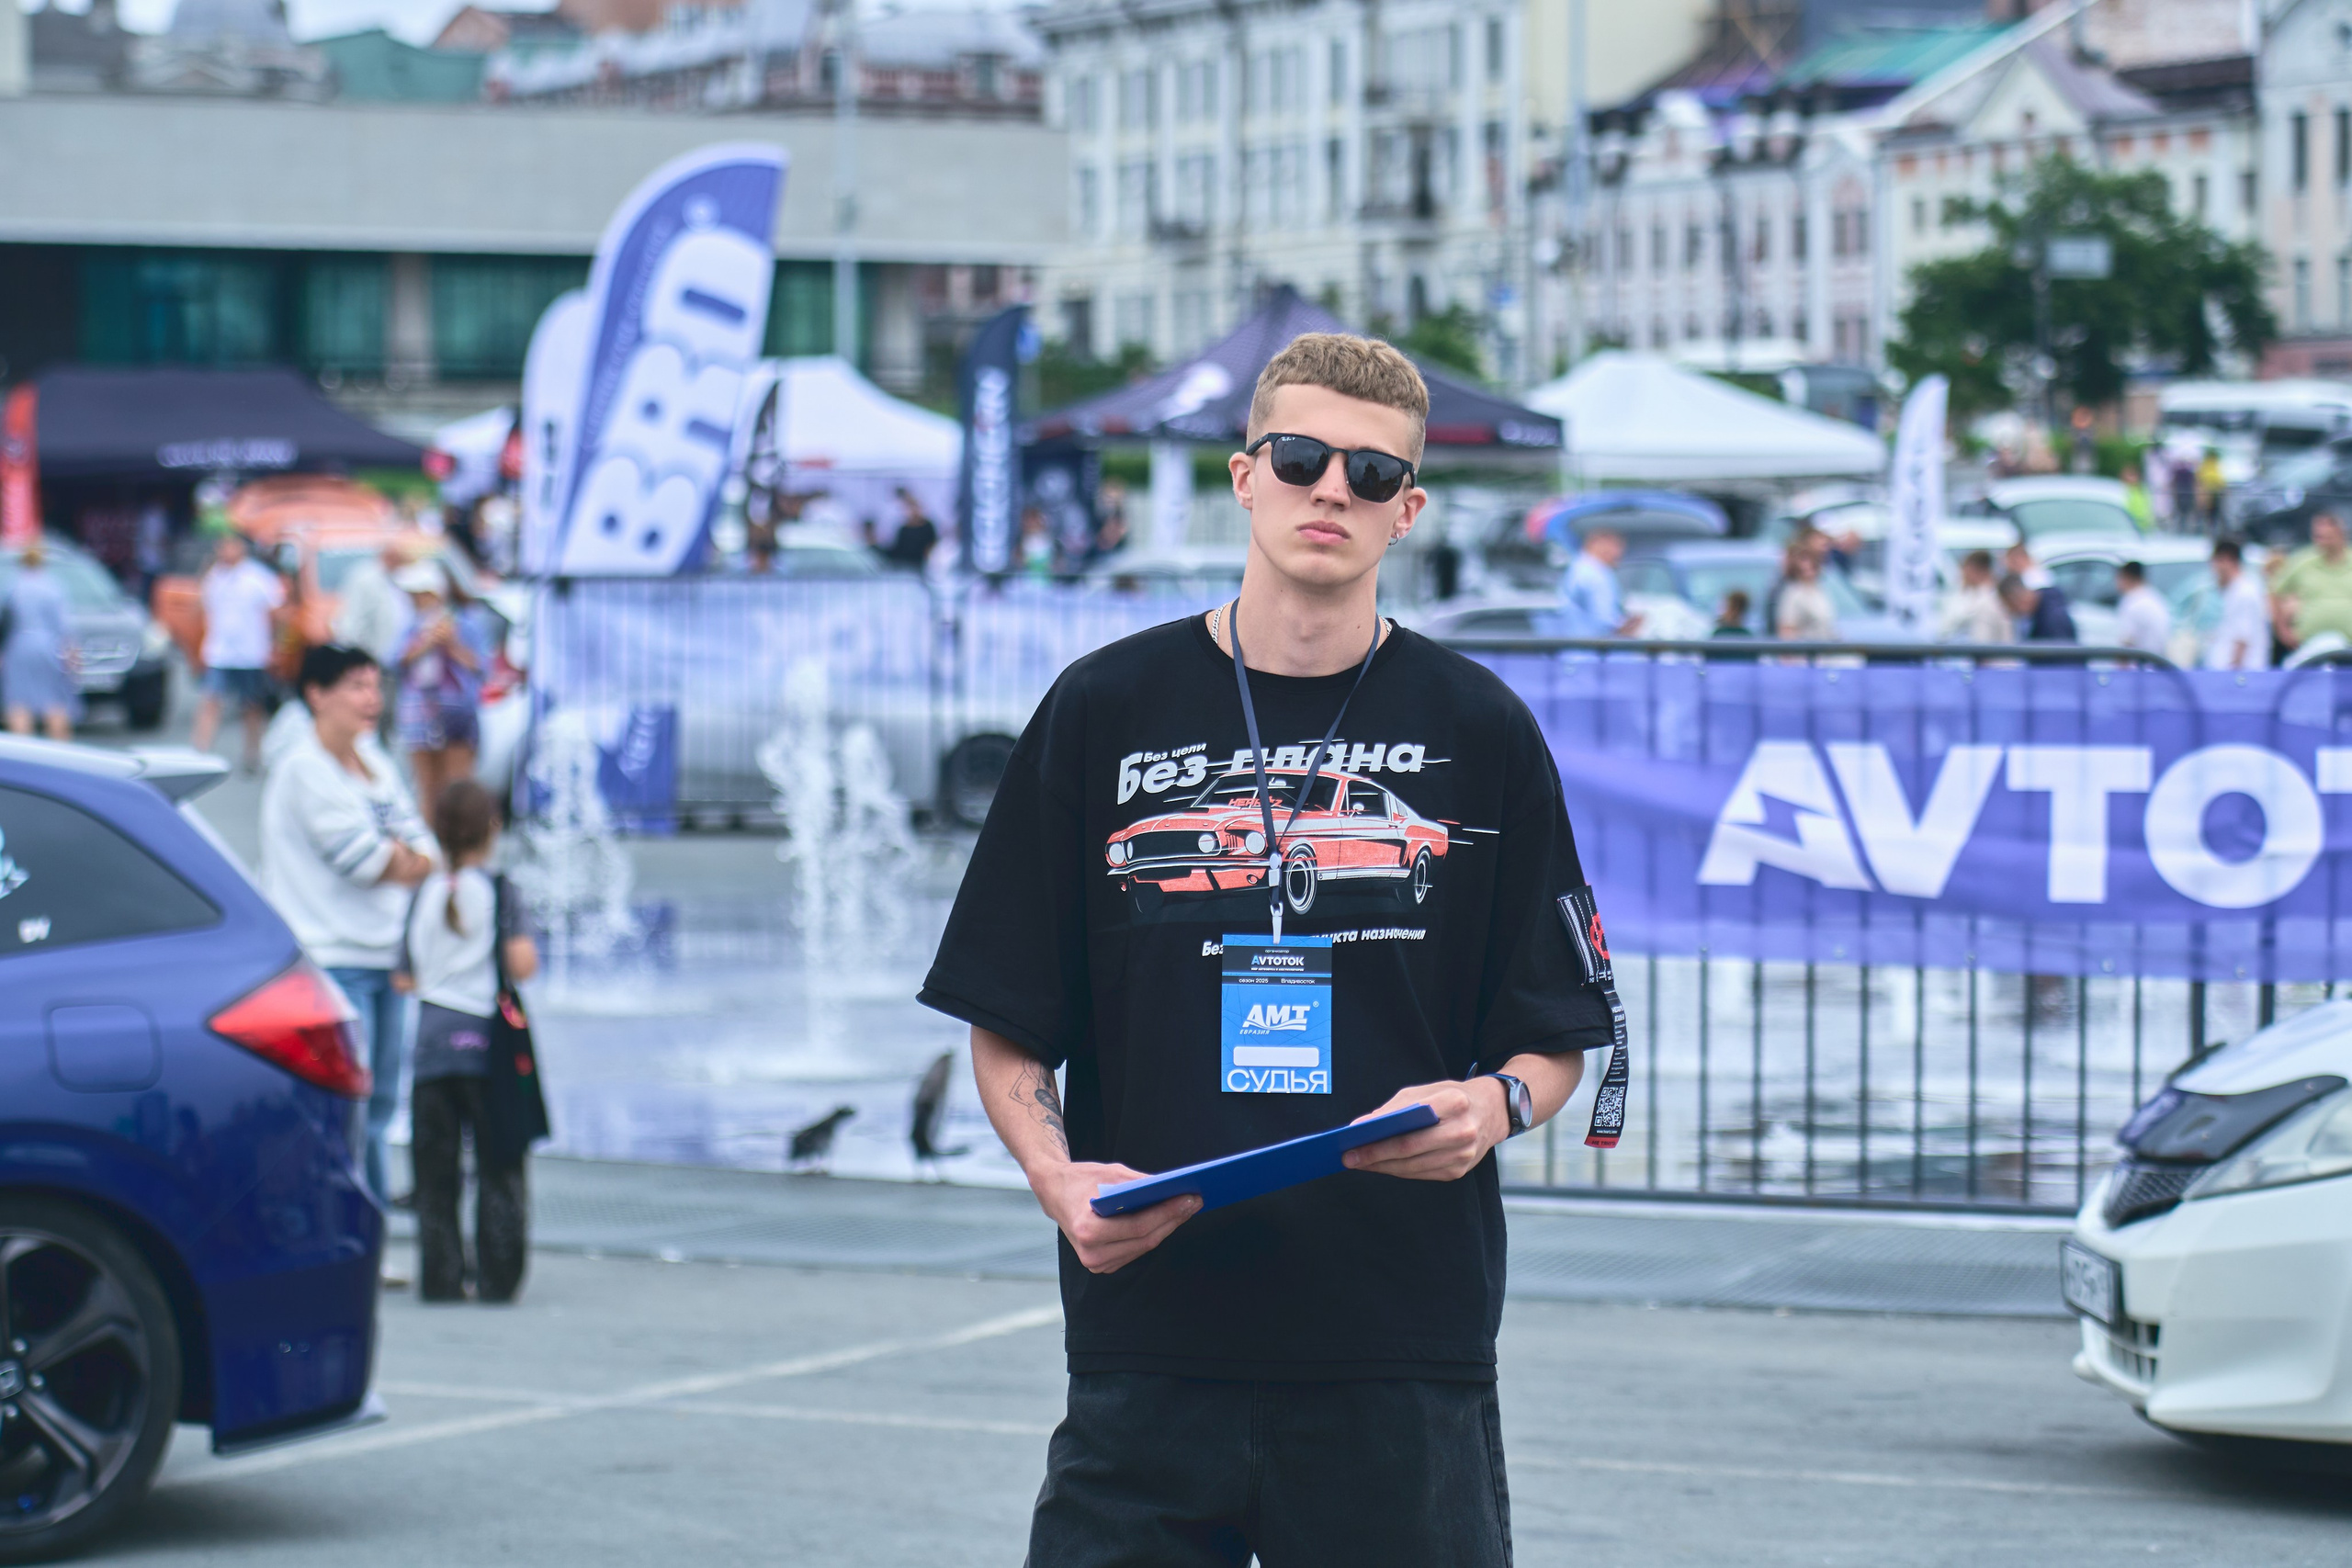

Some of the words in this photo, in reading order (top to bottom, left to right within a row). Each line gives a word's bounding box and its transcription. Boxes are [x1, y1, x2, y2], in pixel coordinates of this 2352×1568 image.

[1143, 752, 1168, 762] Без
[1171, 742, 1207, 758] цели
[1117, 751, 1207, 806] Без
[1698, 740, 2352, 908] AVTO
[1250, 955, 1305, 966] AVTOTOK
[1227, 1069, 1328, 1093] СУДЬЯ
